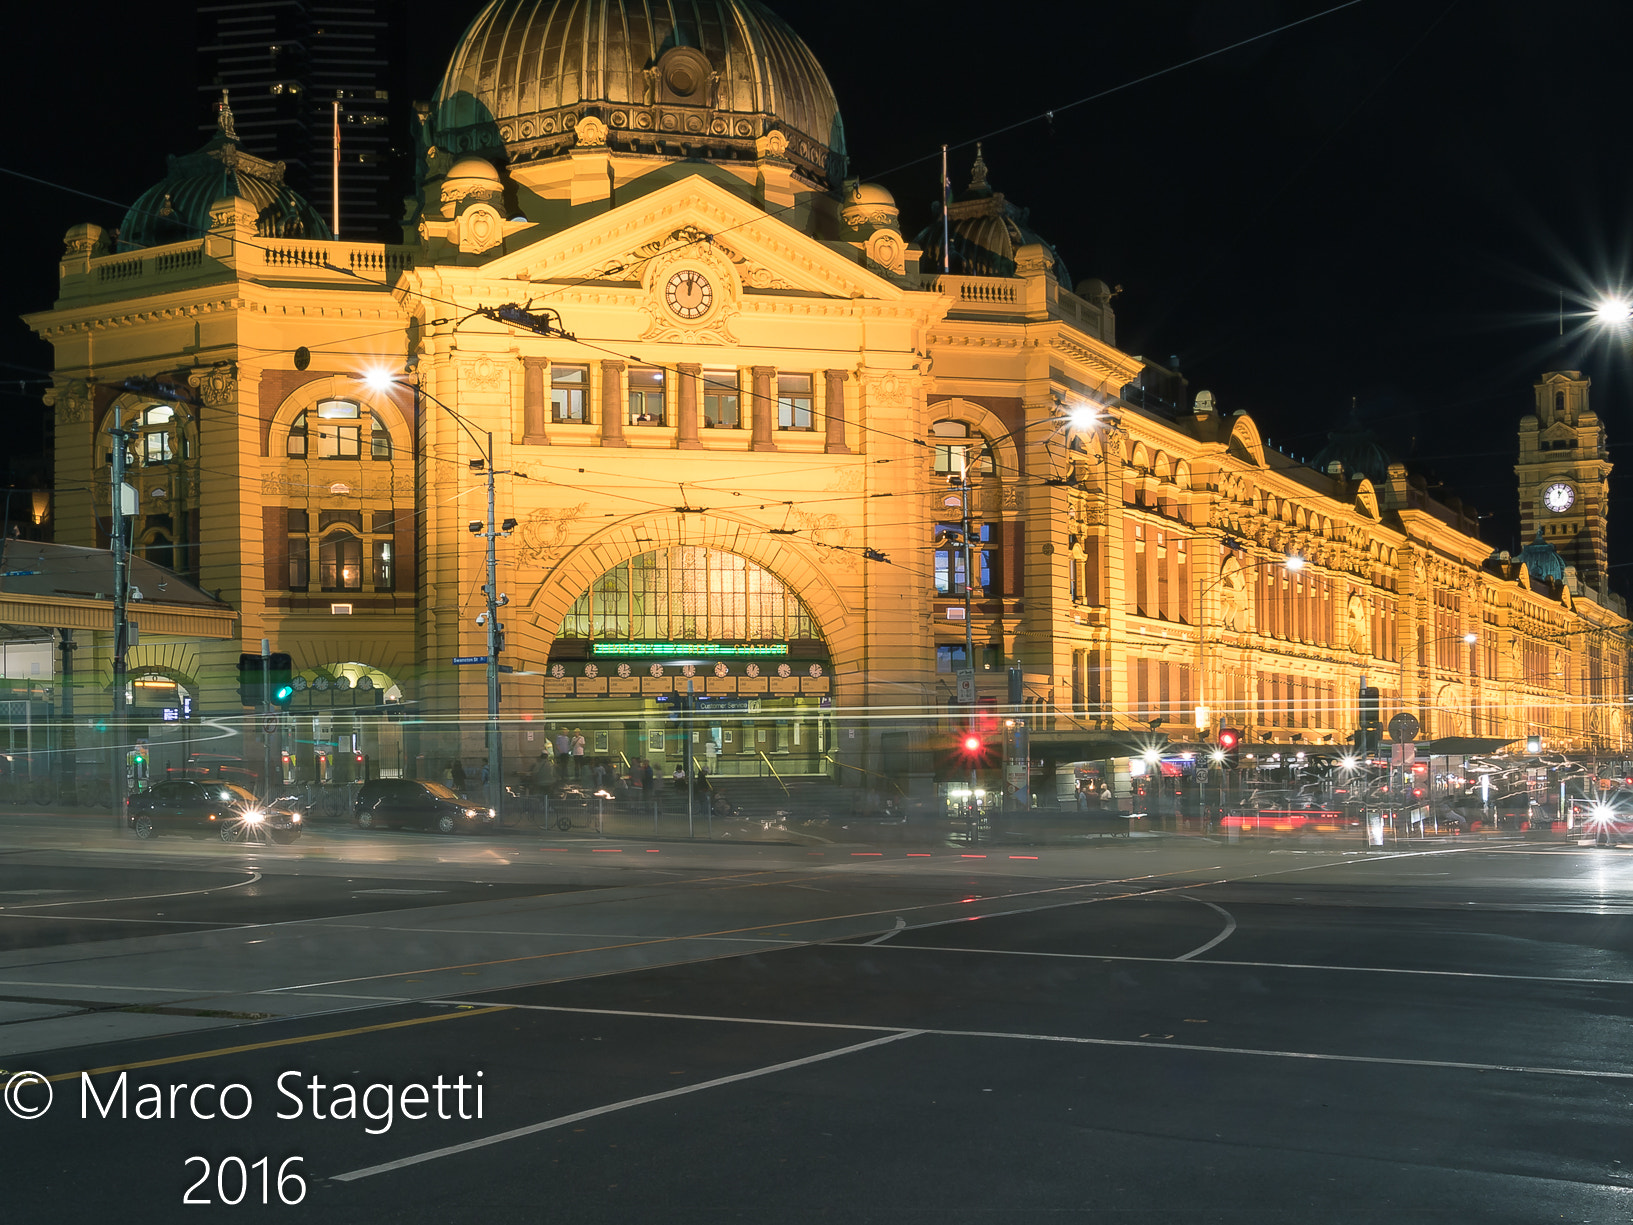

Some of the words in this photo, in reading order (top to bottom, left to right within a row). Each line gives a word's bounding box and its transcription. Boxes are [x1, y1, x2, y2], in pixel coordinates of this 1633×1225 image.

[672, 643, 718, 655] STREET
[733, 643, 789, 655] STATION
[700, 702, 727, 710] Customer
